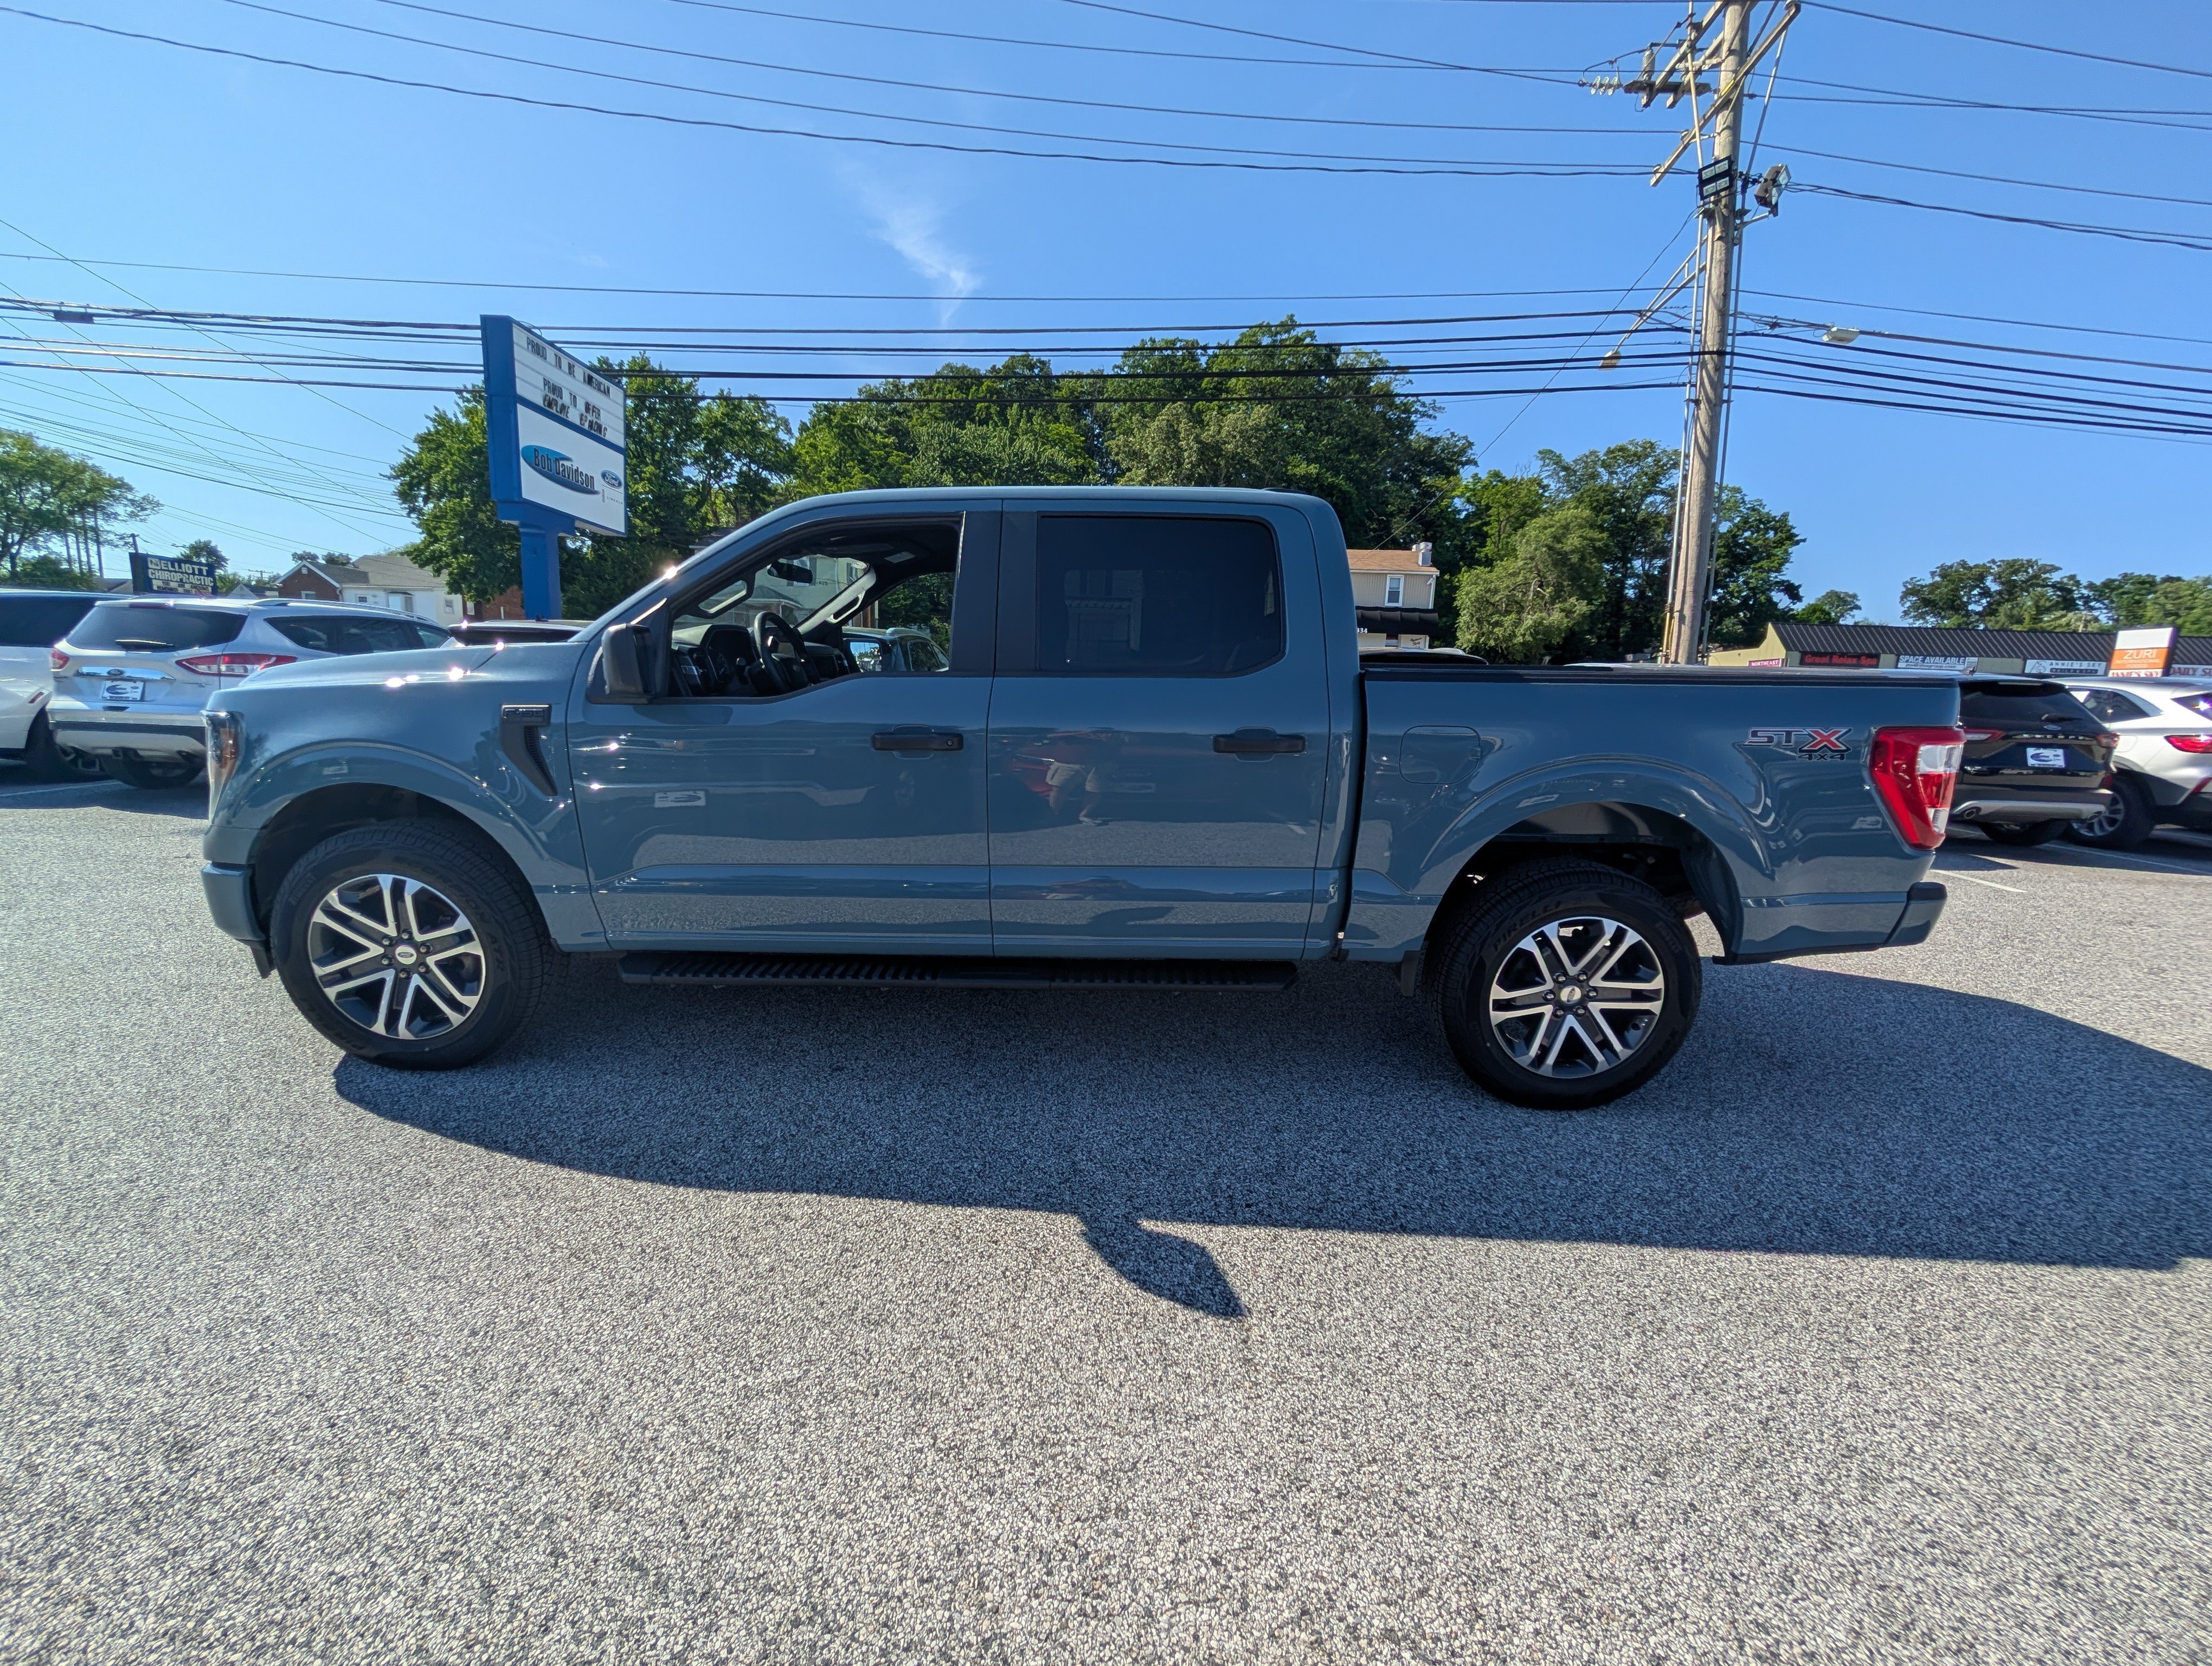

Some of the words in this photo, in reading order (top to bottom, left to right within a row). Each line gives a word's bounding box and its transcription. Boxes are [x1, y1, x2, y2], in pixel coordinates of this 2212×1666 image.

[526, 336, 547, 360] PROUD
[554, 353, 562, 369] TO
[568, 362, 576, 378] BE
[583, 370, 610, 398] AMERICAN
[543, 377, 563, 400] PROUD
[569, 392, 577, 408] TO
[584, 401, 601, 421] OFFER
[533, 447, 552, 472] Bob
[554, 457, 595, 490] Davidson
[603, 472, 620, 487] Ford
[160, 560, 208, 575] ELLIOTT
[148, 569, 214, 586] CHIROPRACTIC
[1804, 654, 1830, 664] Great
[1831, 655, 1858, 664] Relax
[1860, 656, 1878, 665] Spa
[1899, 655, 1923, 663] SPACE
[1925, 656, 1965, 665] AVAILABLE
[2123, 650, 2157, 659] ZURI
[1744, 727, 1852, 753] STX
